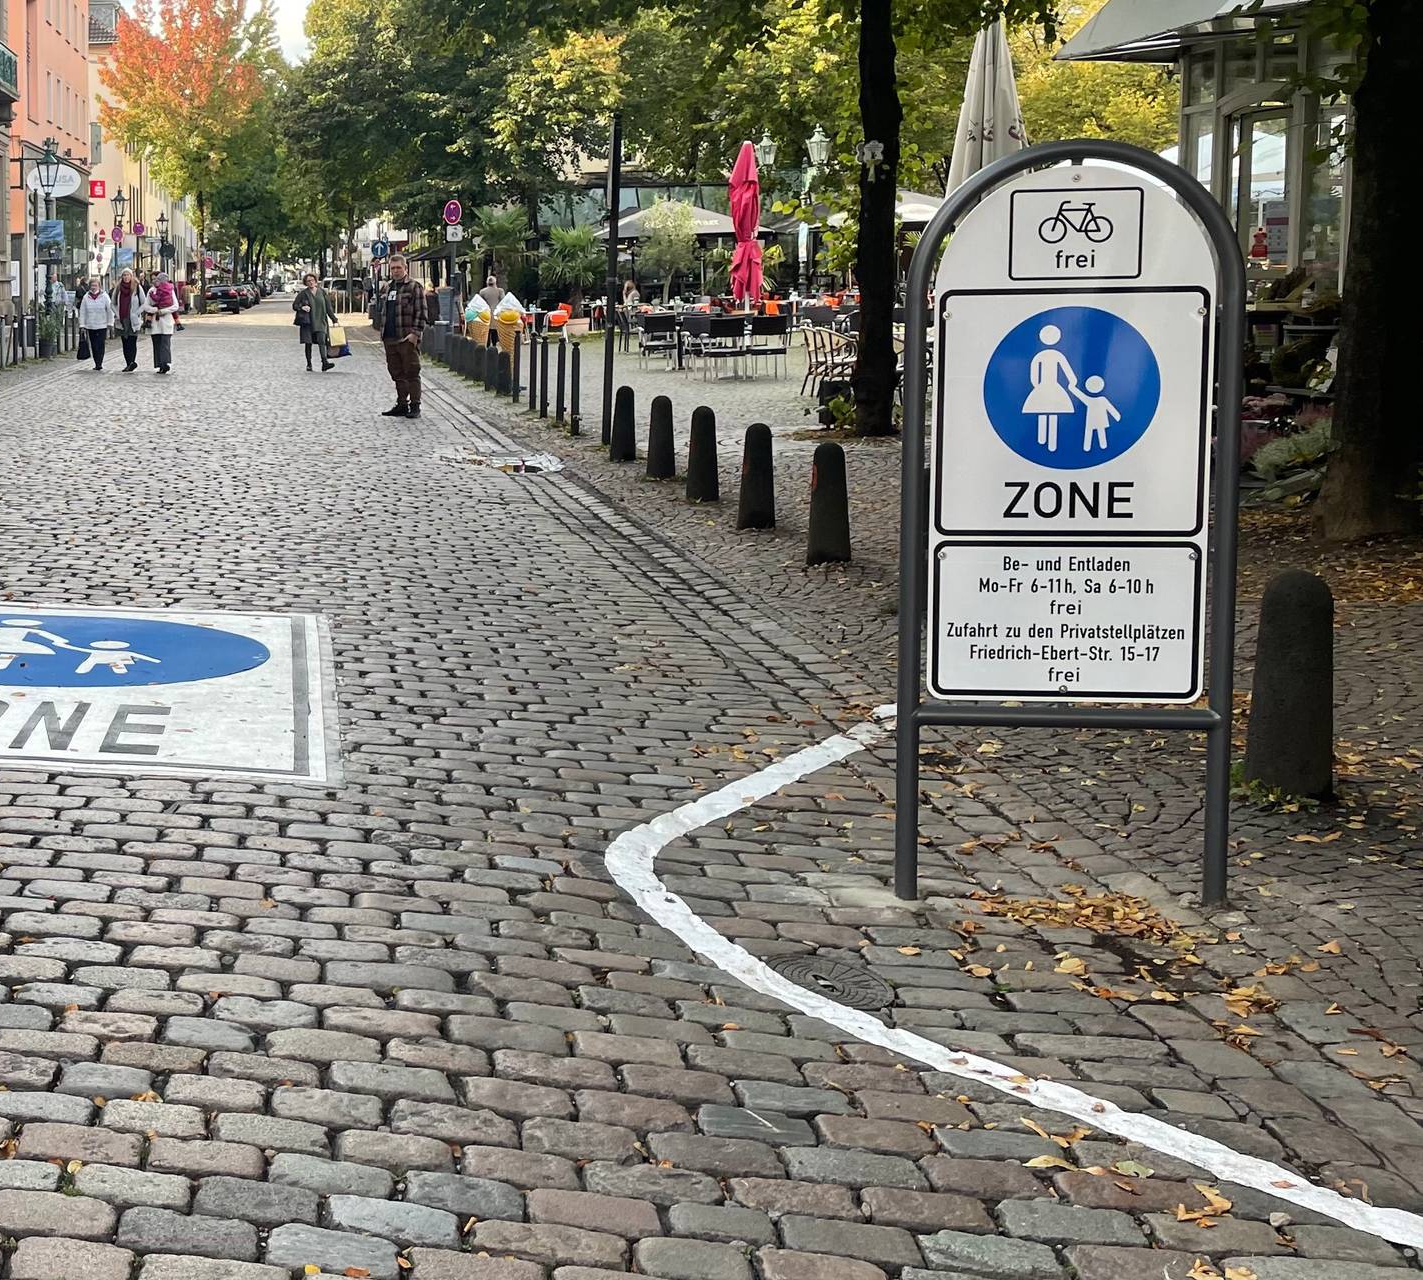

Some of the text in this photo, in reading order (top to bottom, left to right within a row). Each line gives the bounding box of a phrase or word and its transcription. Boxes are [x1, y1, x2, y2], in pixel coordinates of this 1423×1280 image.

[1055, 249, 1096, 269] frei
[1002, 481, 1135, 519] ZONE
[1003, 556, 1131, 572] Be- und Entladen
[979, 578, 1024, 595] Mo-Fr
[1084, 578, 1101, 595] Sa
[1049, 599, 1082, 615] frei
[946, 622, 1185, 643] Zufahrt zu den Privatstellplätzen
[970, 644, 1160, 662] Friedrich-Ebert-Str. 15-17
[1048, 667, 1080, 683] frei
